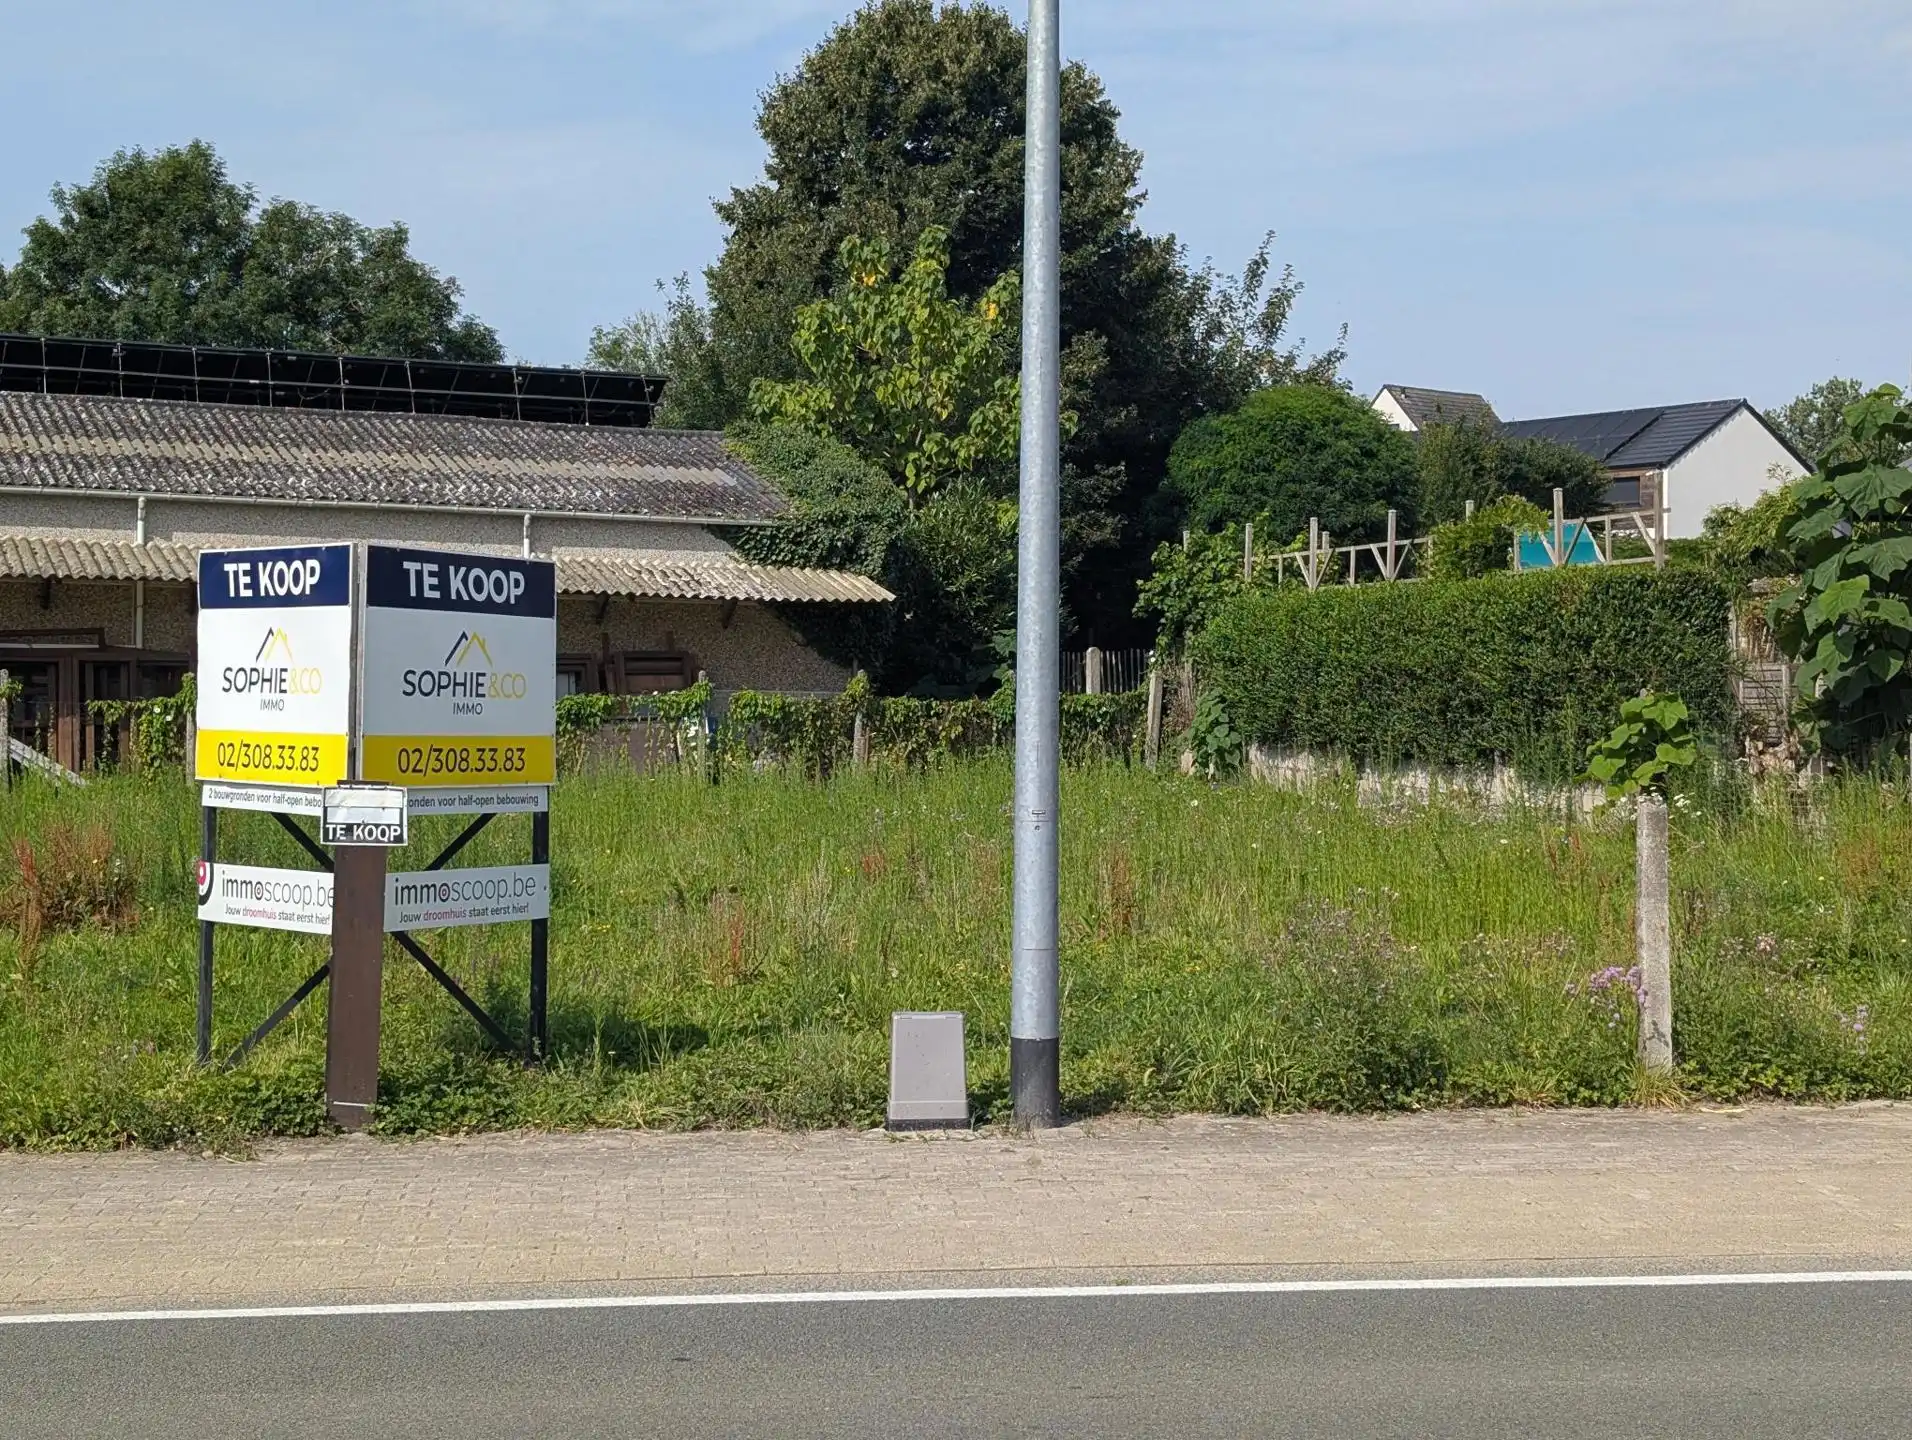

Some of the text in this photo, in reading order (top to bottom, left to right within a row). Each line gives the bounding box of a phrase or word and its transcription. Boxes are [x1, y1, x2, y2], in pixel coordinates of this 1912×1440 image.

[224, 558, 321, 597] TE KOOP
[403, 560, 525, 604] TE KOOP
[222, 667, 322, 694] SOPHIE&CO
[402, 669, 527, 698] SOPHIE&CO
[259, 698, 285, 712] IMMO
[452, 703, 483, 716] IMMO
[217, 739, 319, 774] 02/308.33.83
[397, 744, 526, 776] 02/308.33.83
[208, 788, 213, 799] 2
[213, 789, 255, 803] bouwgronden
[257, 793, 272, 801] voor
[272, 793, 303, 808] half-open
[438, 797, 456, 807] voor
[458, 794, 495, 808] half-open
[496, 793, 539, 806] bebouwing
[325, 824, 347, 841] TE
[394, 872, 536, 906] immoscoop.be
[225, 903, 330, 925] Jouw droomhuis staat eerst hier!
[399, 902, 529, 923] Jouw droomhuis staat eerst hier!
